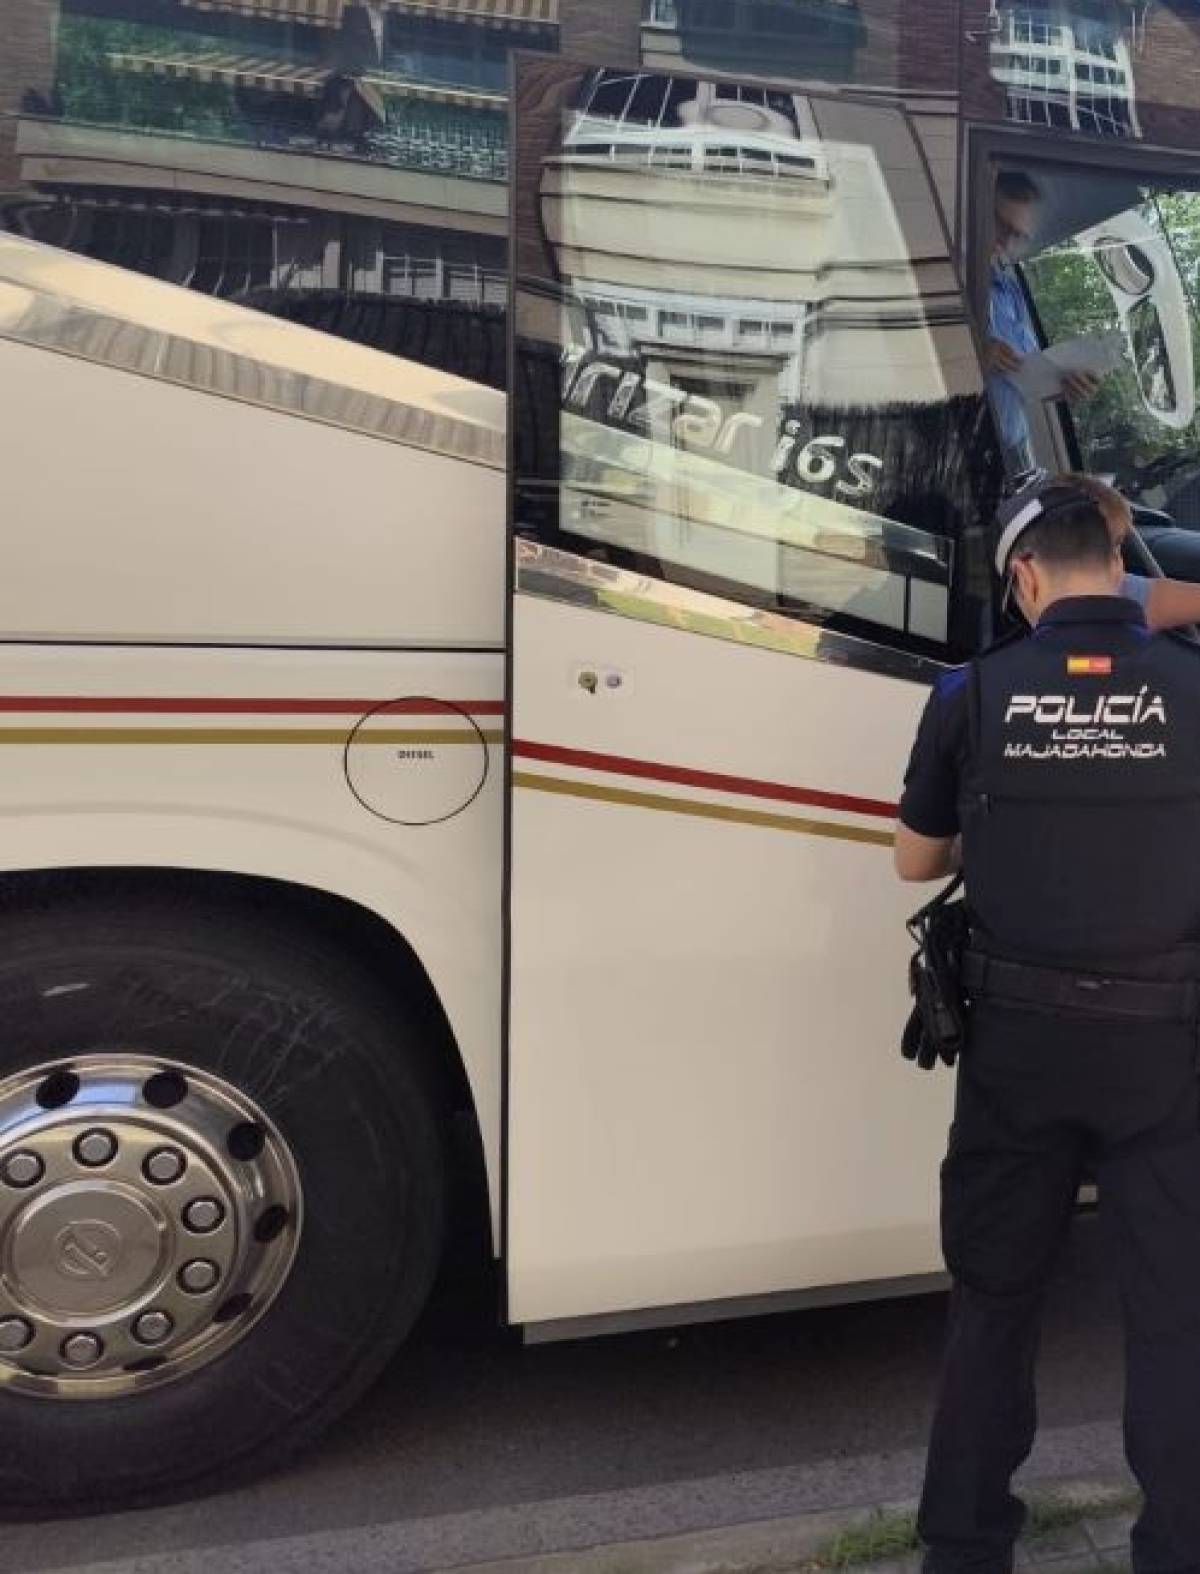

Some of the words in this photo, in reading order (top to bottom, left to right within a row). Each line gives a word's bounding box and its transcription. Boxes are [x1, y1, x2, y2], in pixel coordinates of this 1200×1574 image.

[1004, 683, 1167, 723] POLICÍA
[1052, 728, 1124, 740] LOCAL
[397, 750, 435, 759] DIESEL
[1004, 743, 1166, 759] MAJADAHONDA
